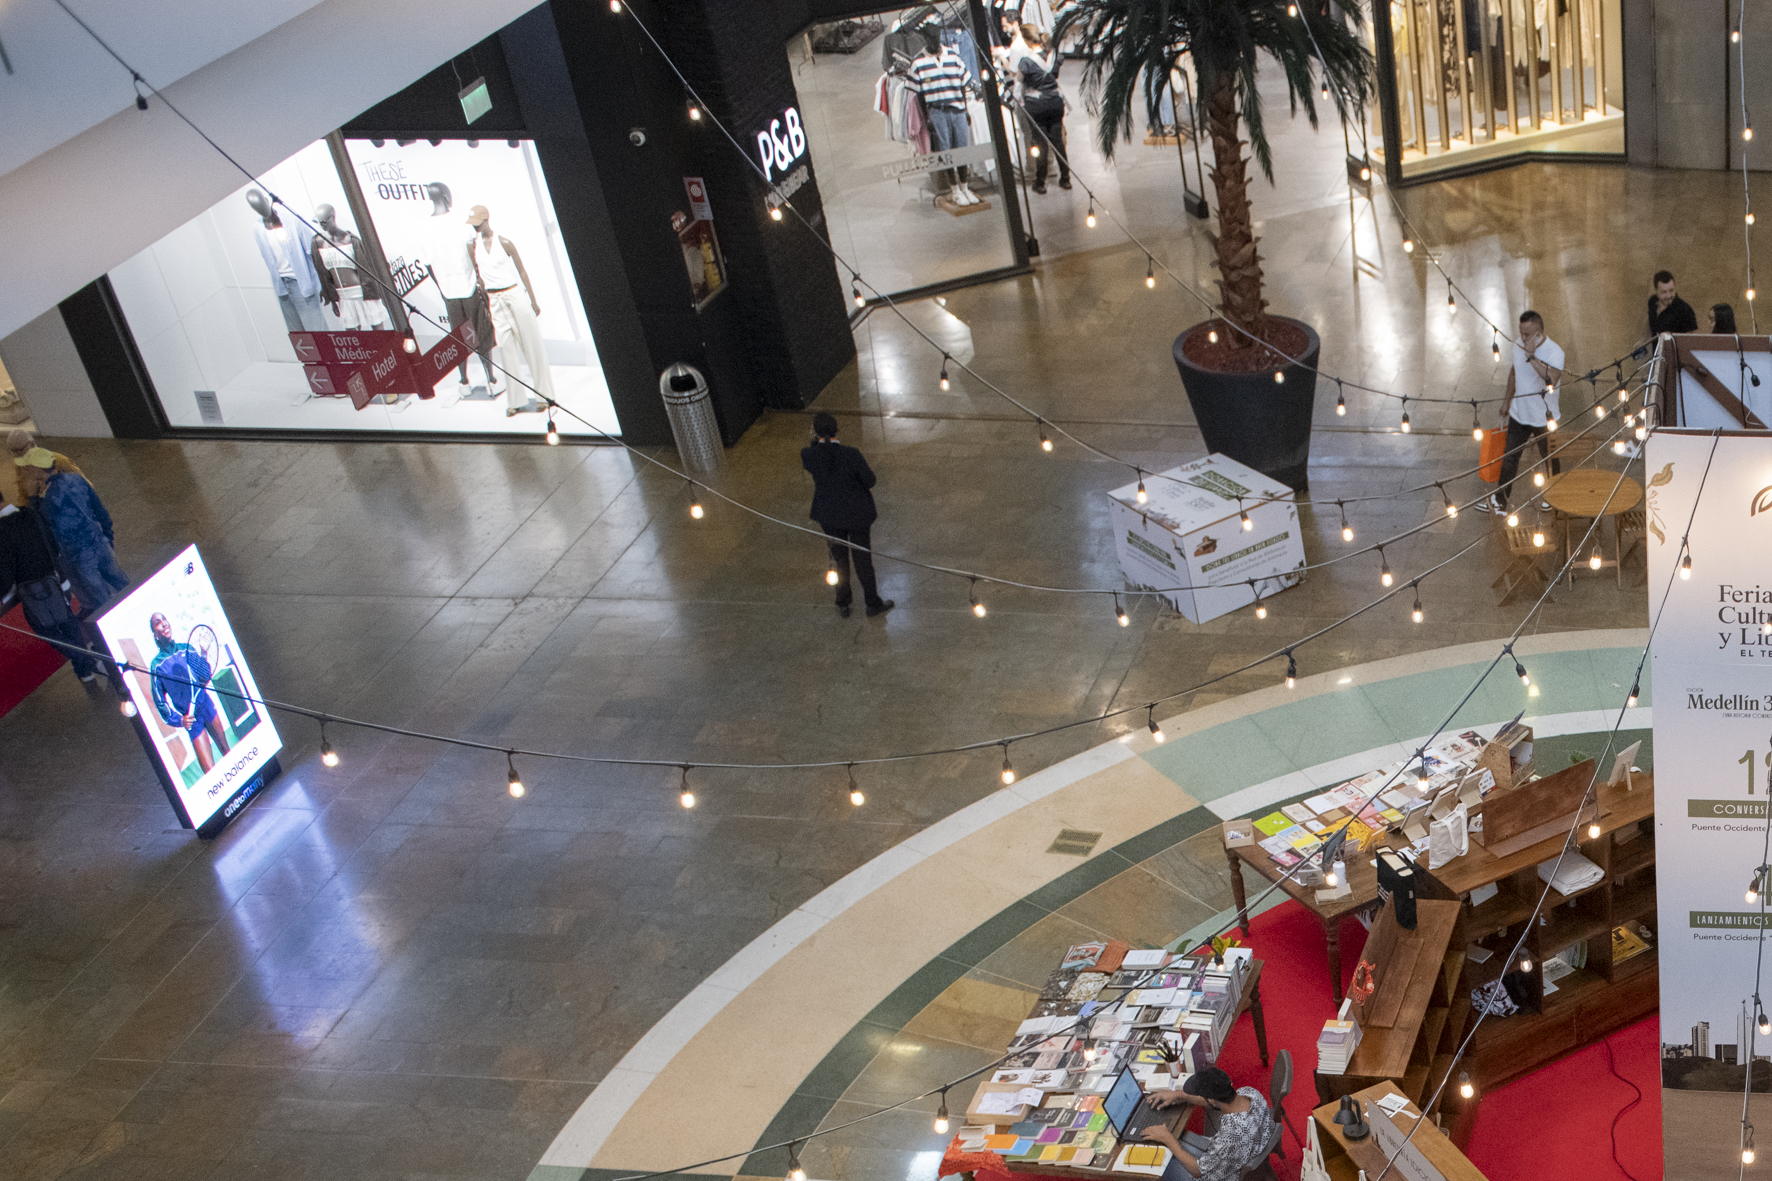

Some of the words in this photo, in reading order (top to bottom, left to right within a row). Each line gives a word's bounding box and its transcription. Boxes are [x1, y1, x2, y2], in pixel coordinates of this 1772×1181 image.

[757, 107, 805, 182] P&B
[328, 333, 360, 348] Torre
[371, 349, 398, 382] Hotel
[433, 343, 459, 371] Cines
[1718, 631, 1732, 649] y
[1687, 693, 1760, 711] Medellín
[207, 778, 225, 799] new
[224, 746, 259, 782] balance
[1691, 823, 1722, 832] Puente
[1723, 824, 1766, 833] Occidente
[1697, 915, 1769, 926] LANZAMIENTOS
[1693, 933, 1722, 941] Puente
